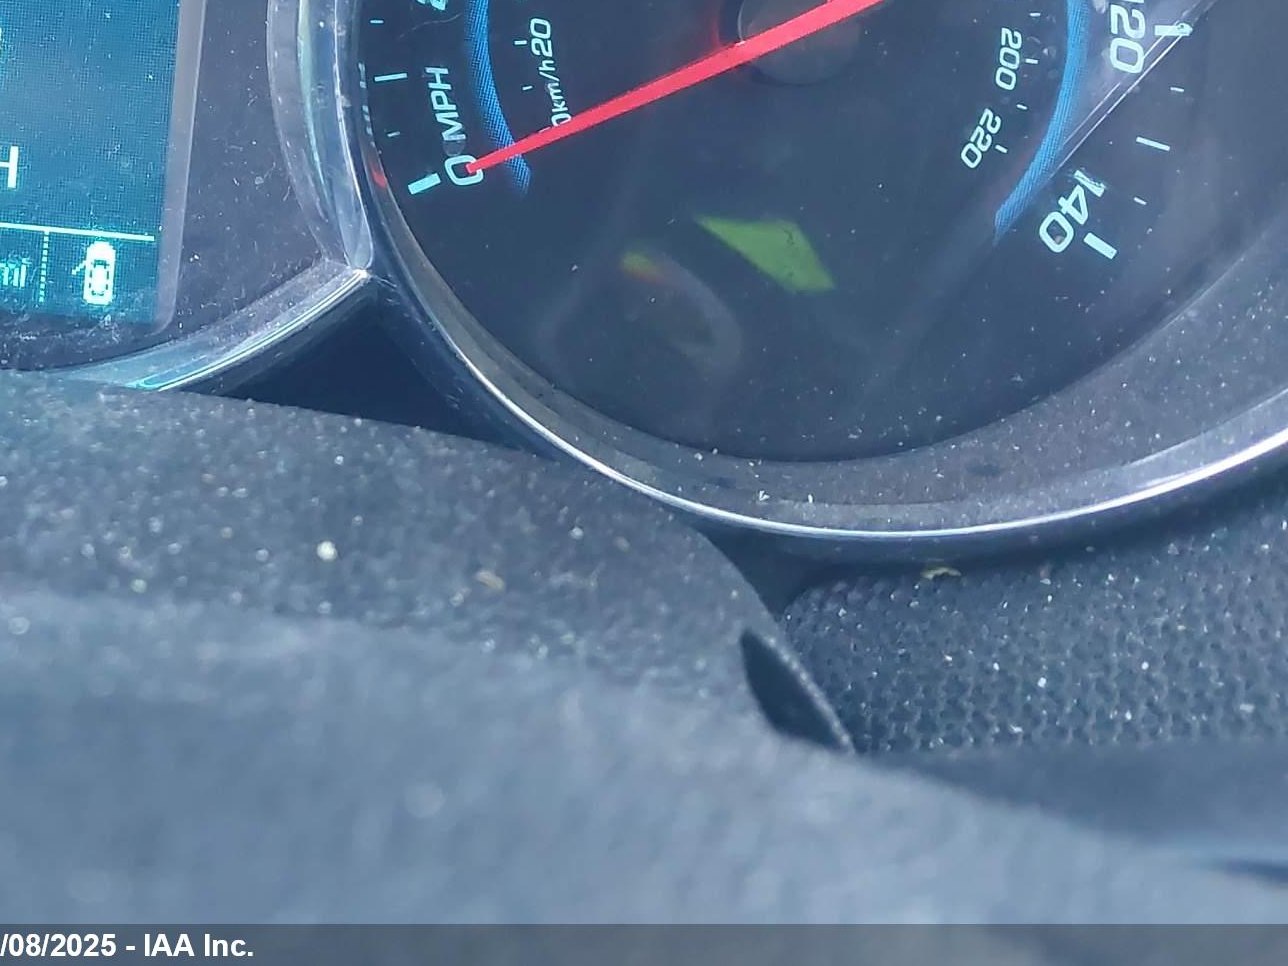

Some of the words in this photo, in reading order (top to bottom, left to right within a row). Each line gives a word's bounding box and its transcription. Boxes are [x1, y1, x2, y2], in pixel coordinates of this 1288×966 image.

[530, 18, 553, 57] 20
[995, 27, 1022, 91] 200
[425, 66, 466, 141] MPH
[961, 108, 1002, 169] 220
[444, 155, 484, 186] 0
[1039, 169, 1106, 253] 140
